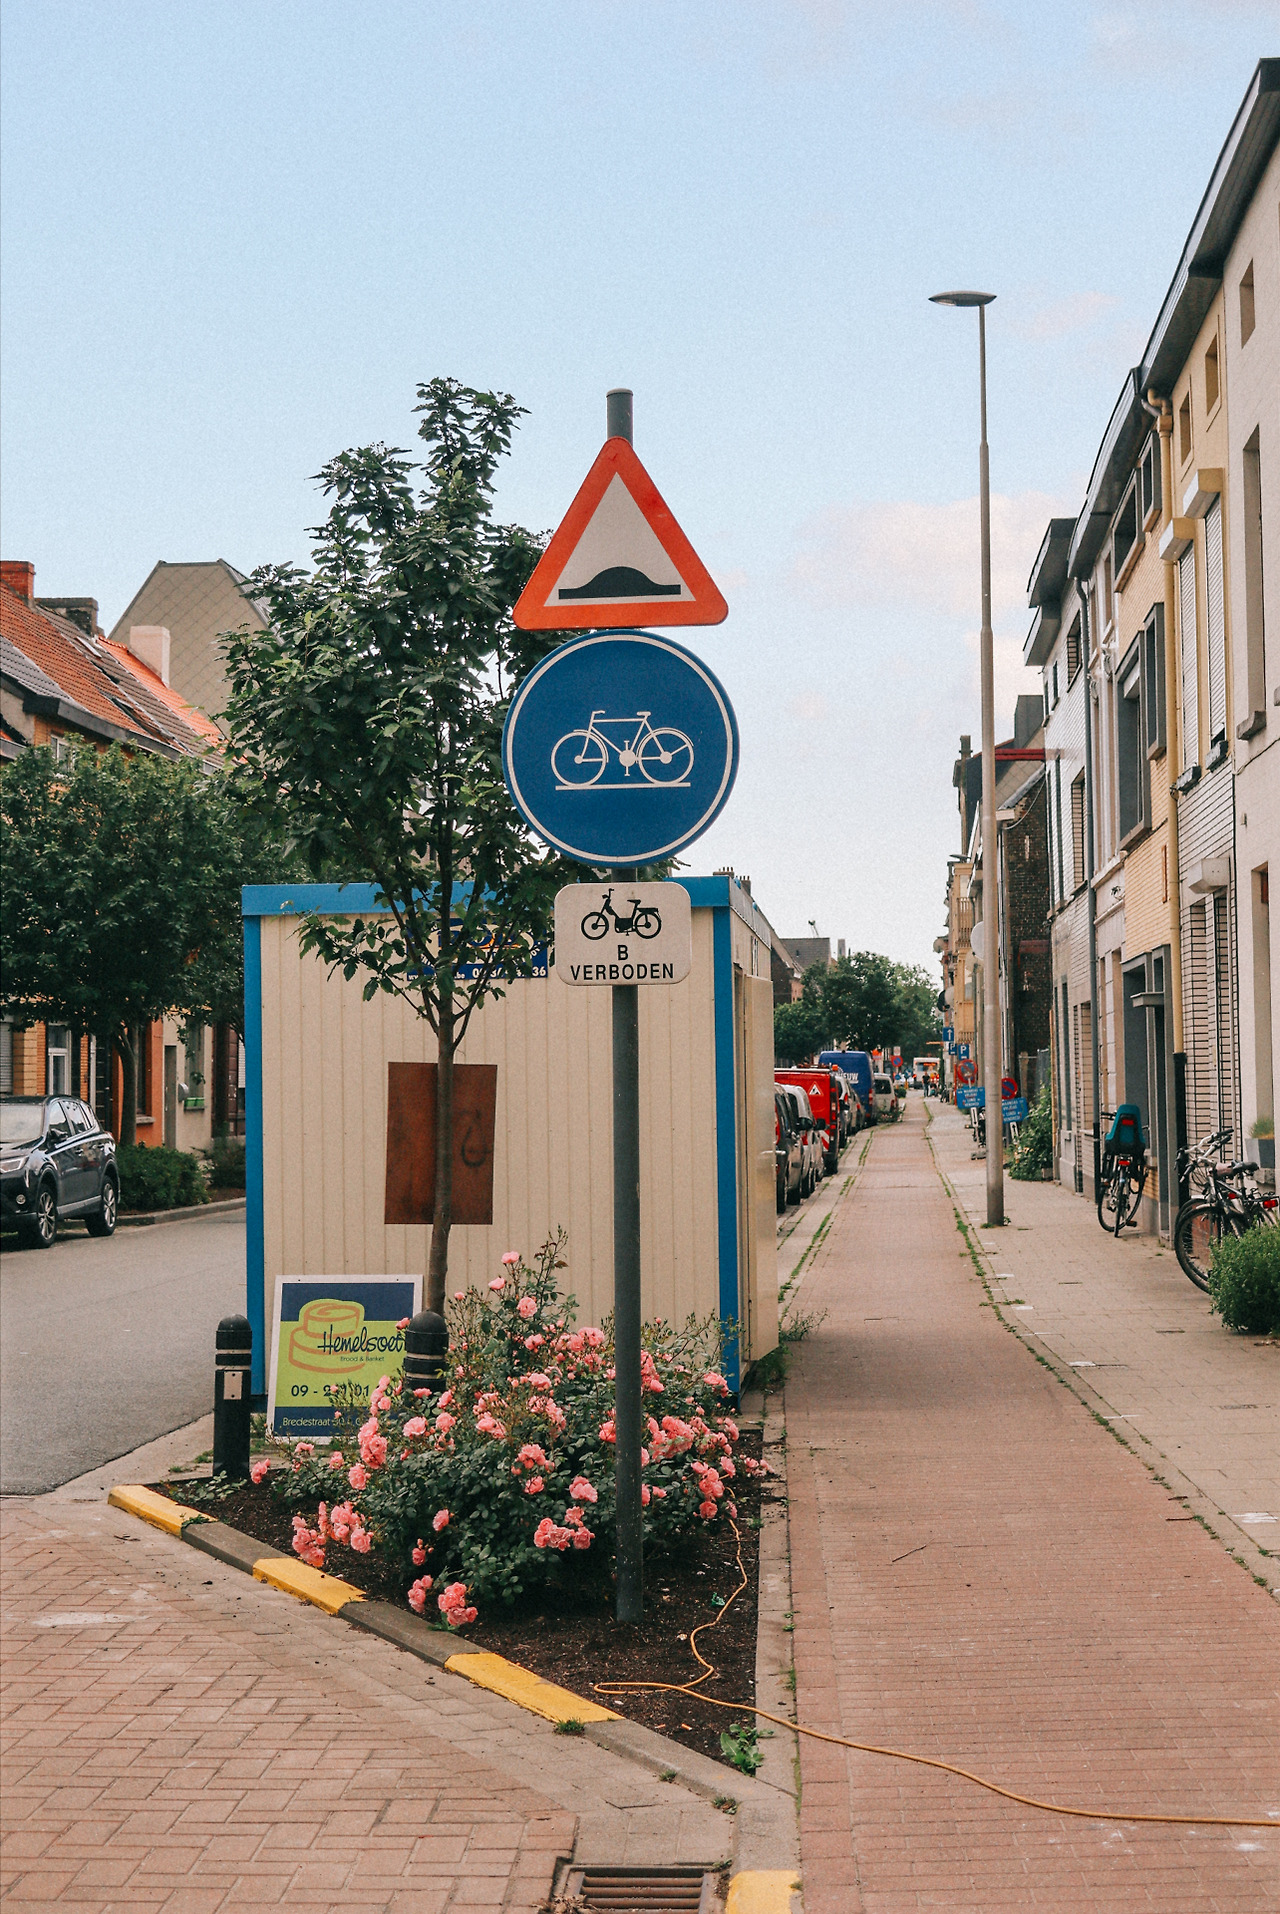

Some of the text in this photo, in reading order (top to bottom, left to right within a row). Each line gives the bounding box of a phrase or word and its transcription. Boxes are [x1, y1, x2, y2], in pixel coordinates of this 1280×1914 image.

[617, 944, 629, 961] B
[570, 963, 674, 981] VERBODEN
[317, 1324, 404, 1355] Hemelsoet
[291, 1384, 309, 1397] 09
[282, 1416, 331, 1427] Bredestraat
